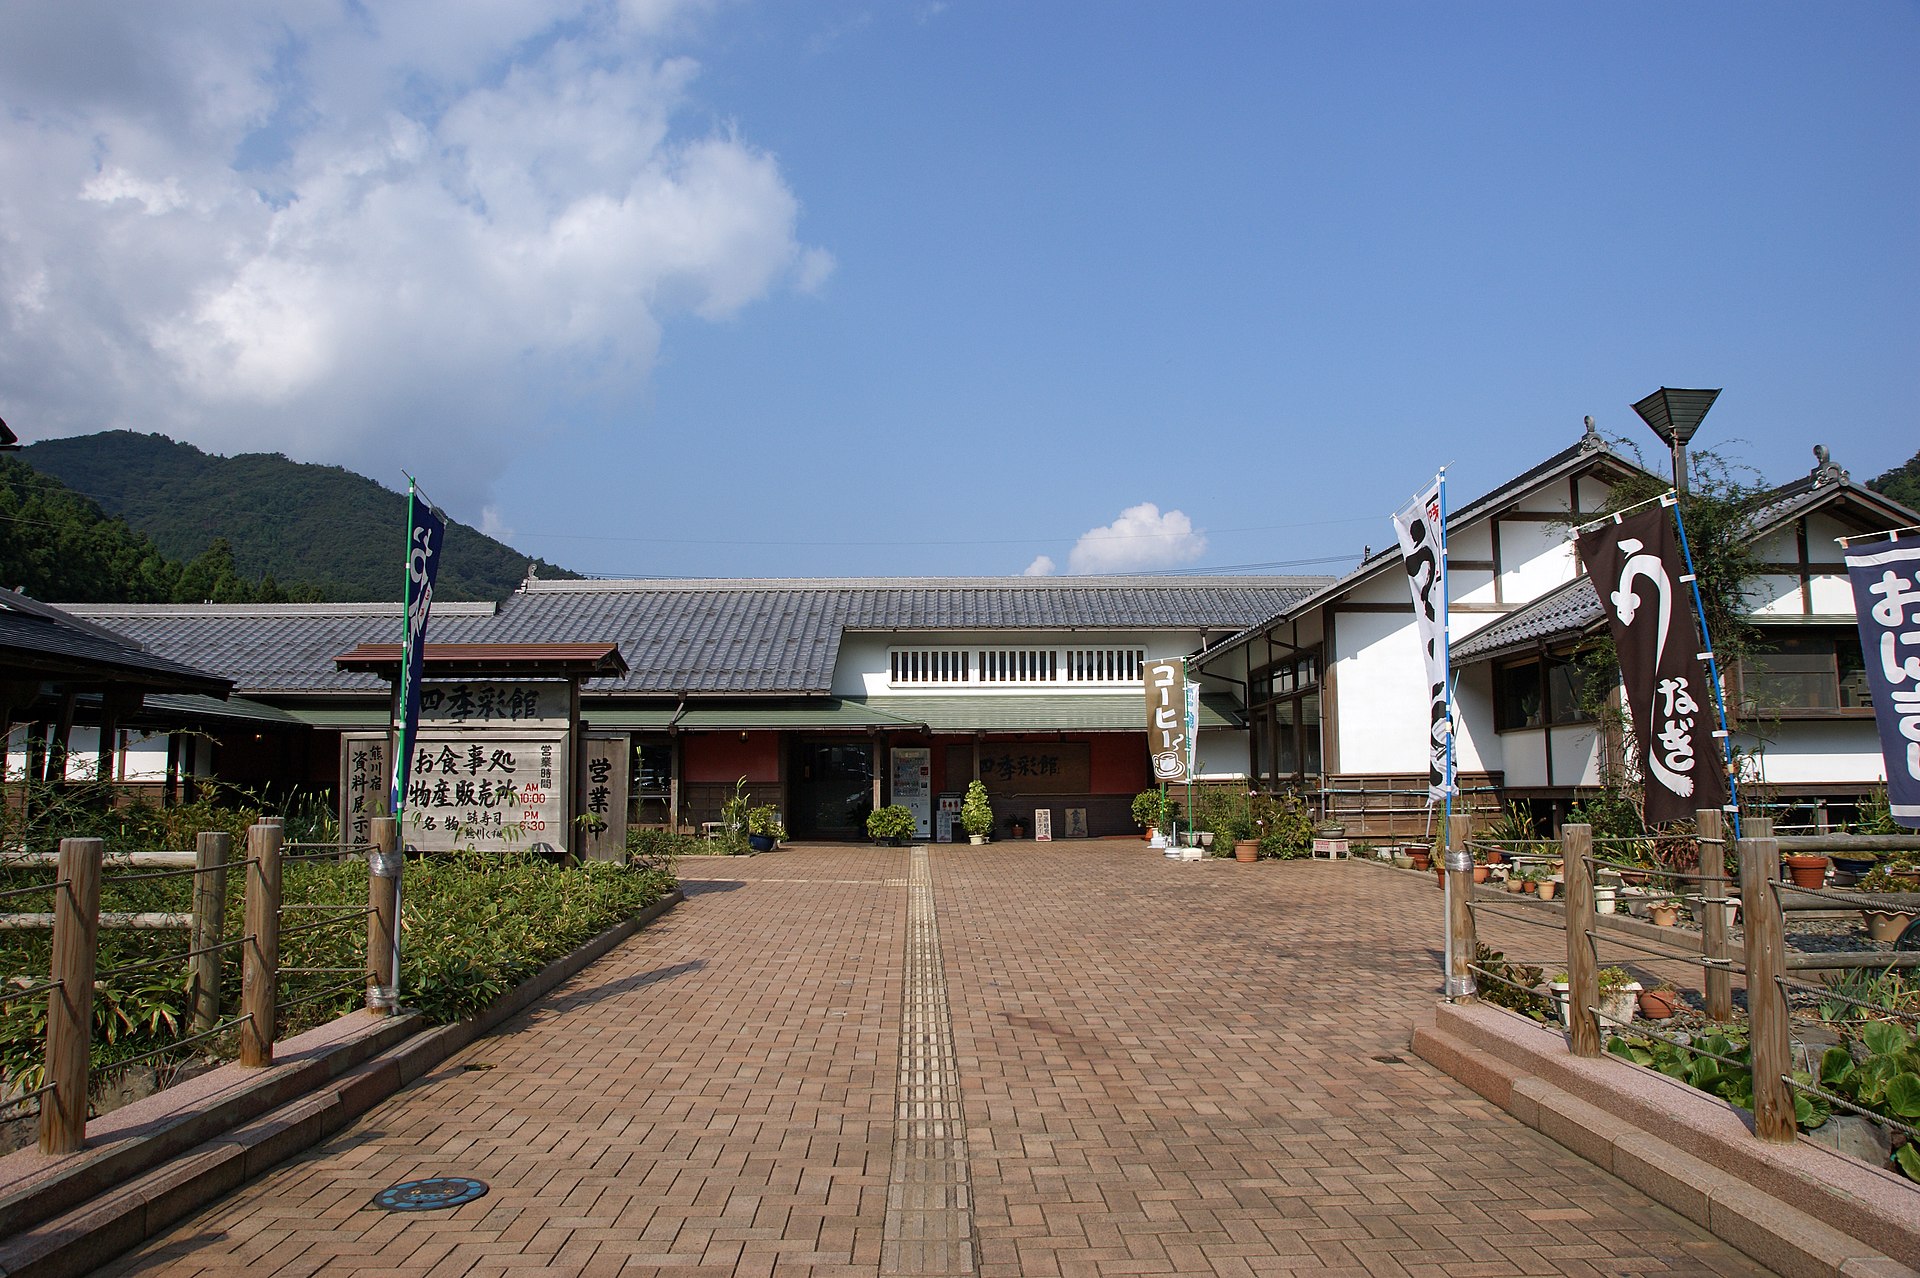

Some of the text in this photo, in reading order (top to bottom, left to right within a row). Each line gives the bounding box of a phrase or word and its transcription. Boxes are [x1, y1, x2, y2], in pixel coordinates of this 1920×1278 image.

[420, 684, 540, 724] 四季彩館
[1152, 665, 1178, 748] コーヒー
[370, 745, 383, 791] 熊川宿
[415, 744, 517, 776] お食事処
[540, 745, 552, 789] 営業時間
[409, 778, 518, 808] 物産販売所
[520, 793, 546, 804] 10:00
[525, 783, 539, 792] AM
[588, 758, 612, 841] 営業中
[422, 815, 460, 831] 名物
[519, 820, 545, 831] 6:30
[524, 811, 539, 820] PM
